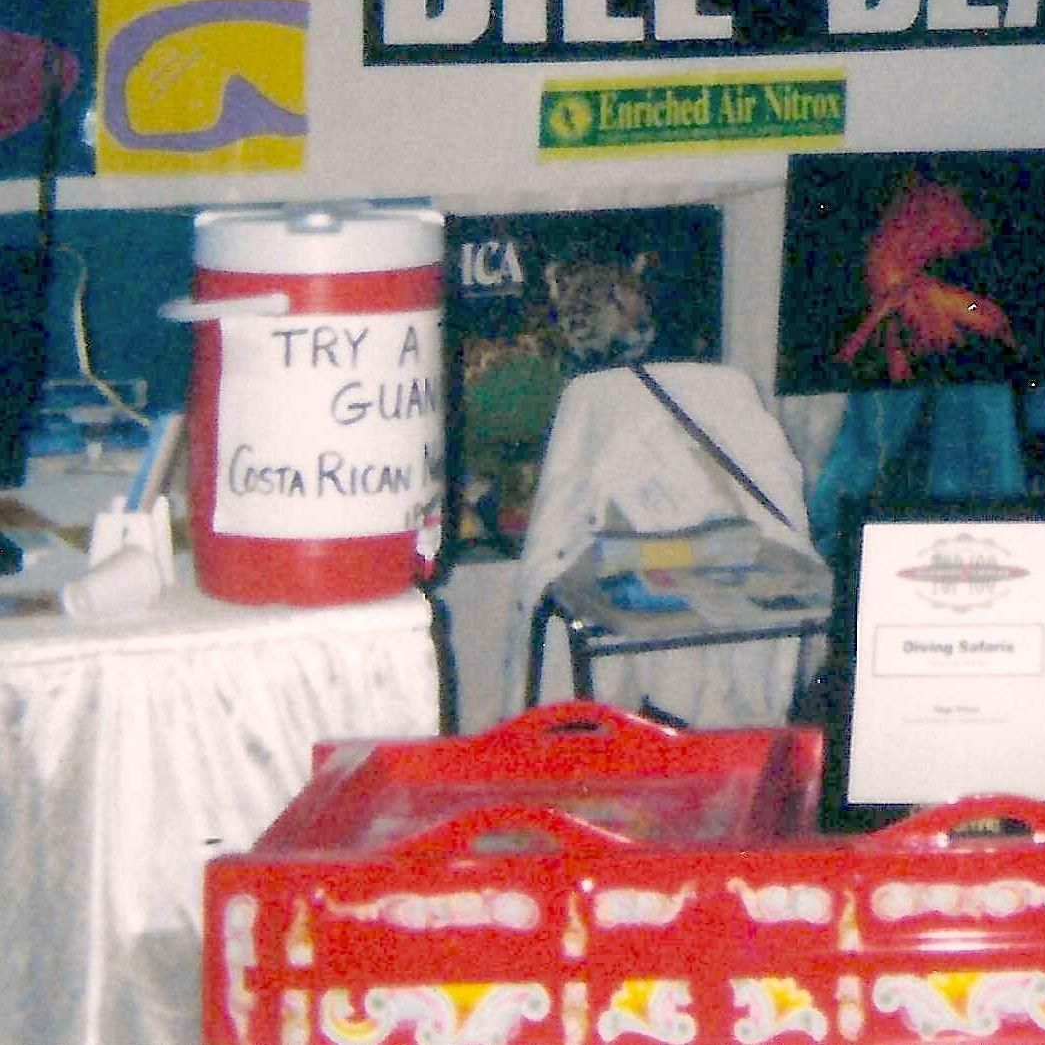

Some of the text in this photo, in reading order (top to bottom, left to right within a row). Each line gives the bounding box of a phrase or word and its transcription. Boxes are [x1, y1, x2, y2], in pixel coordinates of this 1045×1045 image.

[600, 84, 842, 129] Enriched Air Nitrox
[271, 326, 420, 368] TRY A
